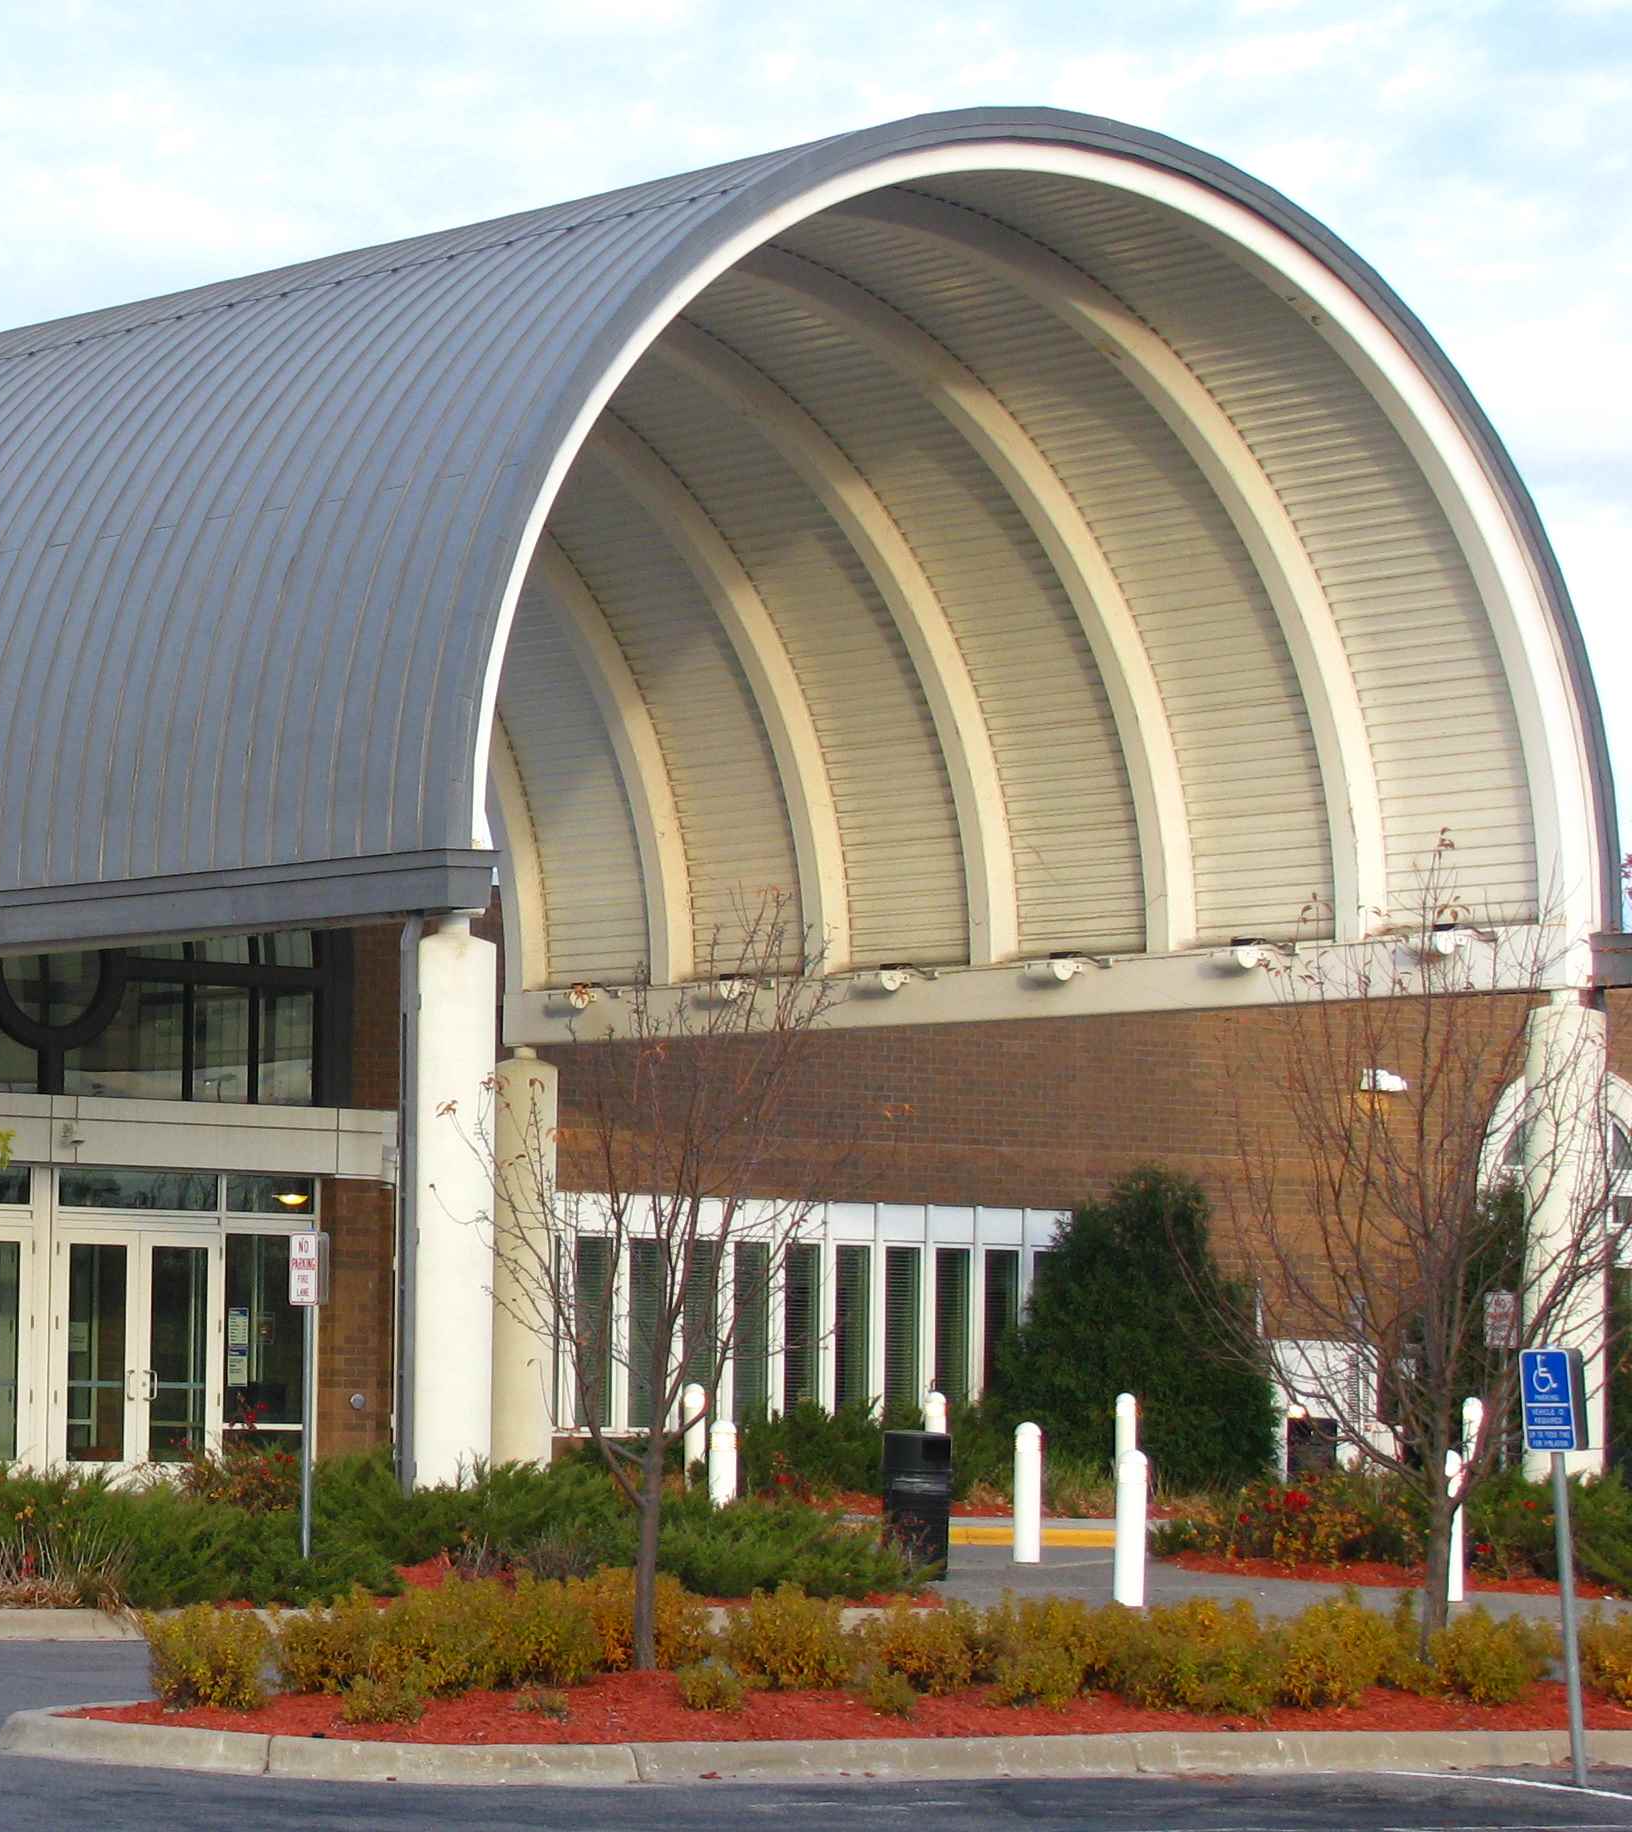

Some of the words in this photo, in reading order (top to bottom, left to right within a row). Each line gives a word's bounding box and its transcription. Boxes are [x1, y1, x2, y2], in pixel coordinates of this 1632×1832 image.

[298, 1240, 310, 1253] NO
[290, 1258, 317, 1270] PARKING
[296, 1287, 310, 1297] LANE
